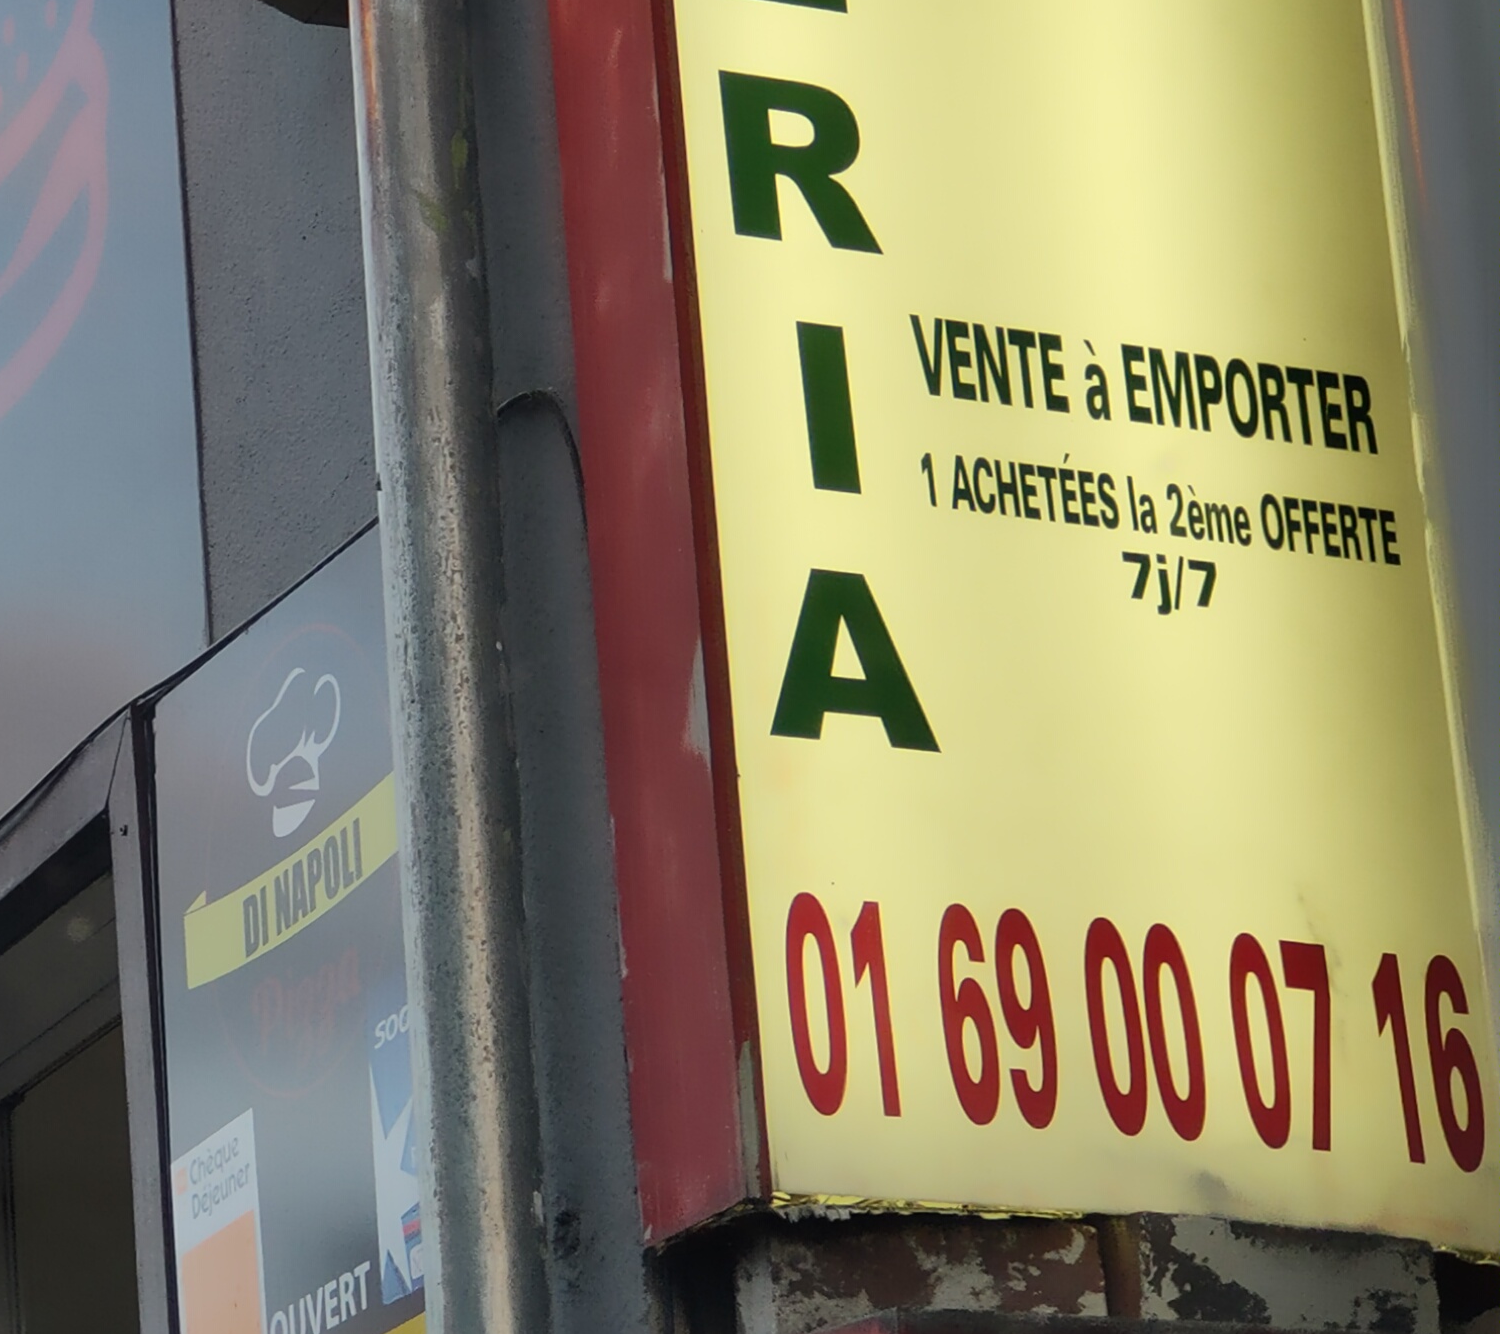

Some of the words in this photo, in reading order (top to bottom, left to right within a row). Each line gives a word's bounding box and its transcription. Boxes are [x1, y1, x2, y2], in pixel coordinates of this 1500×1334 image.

[909, 314, 1070, 414] VENTE
[1083, 339, 1111, 421] à
[1121, 343, 1378, 455] EMPORTER
[920, 452, 938, 507] 1
[952, 452, 1120, 530] ACHETÉES
[1127, 475, 1158, 534] la
[1166, 483, 1252, 546] 2ème
[1260, 493, 1401, 566] OFFERTE
[1122, 551, 1217, 616] 7j/7
[242, 886, 269, 959] DI
[274, 817, 363, 937] NAPOLI
[785, 891, 902, 1117] 01
[938, 903, 1058, 1129] 69
[1084, 916, 1207, 1141] 00
[1229, 932, 1331, 1152] 07
[1372, 951, 1485, 1173] 16
